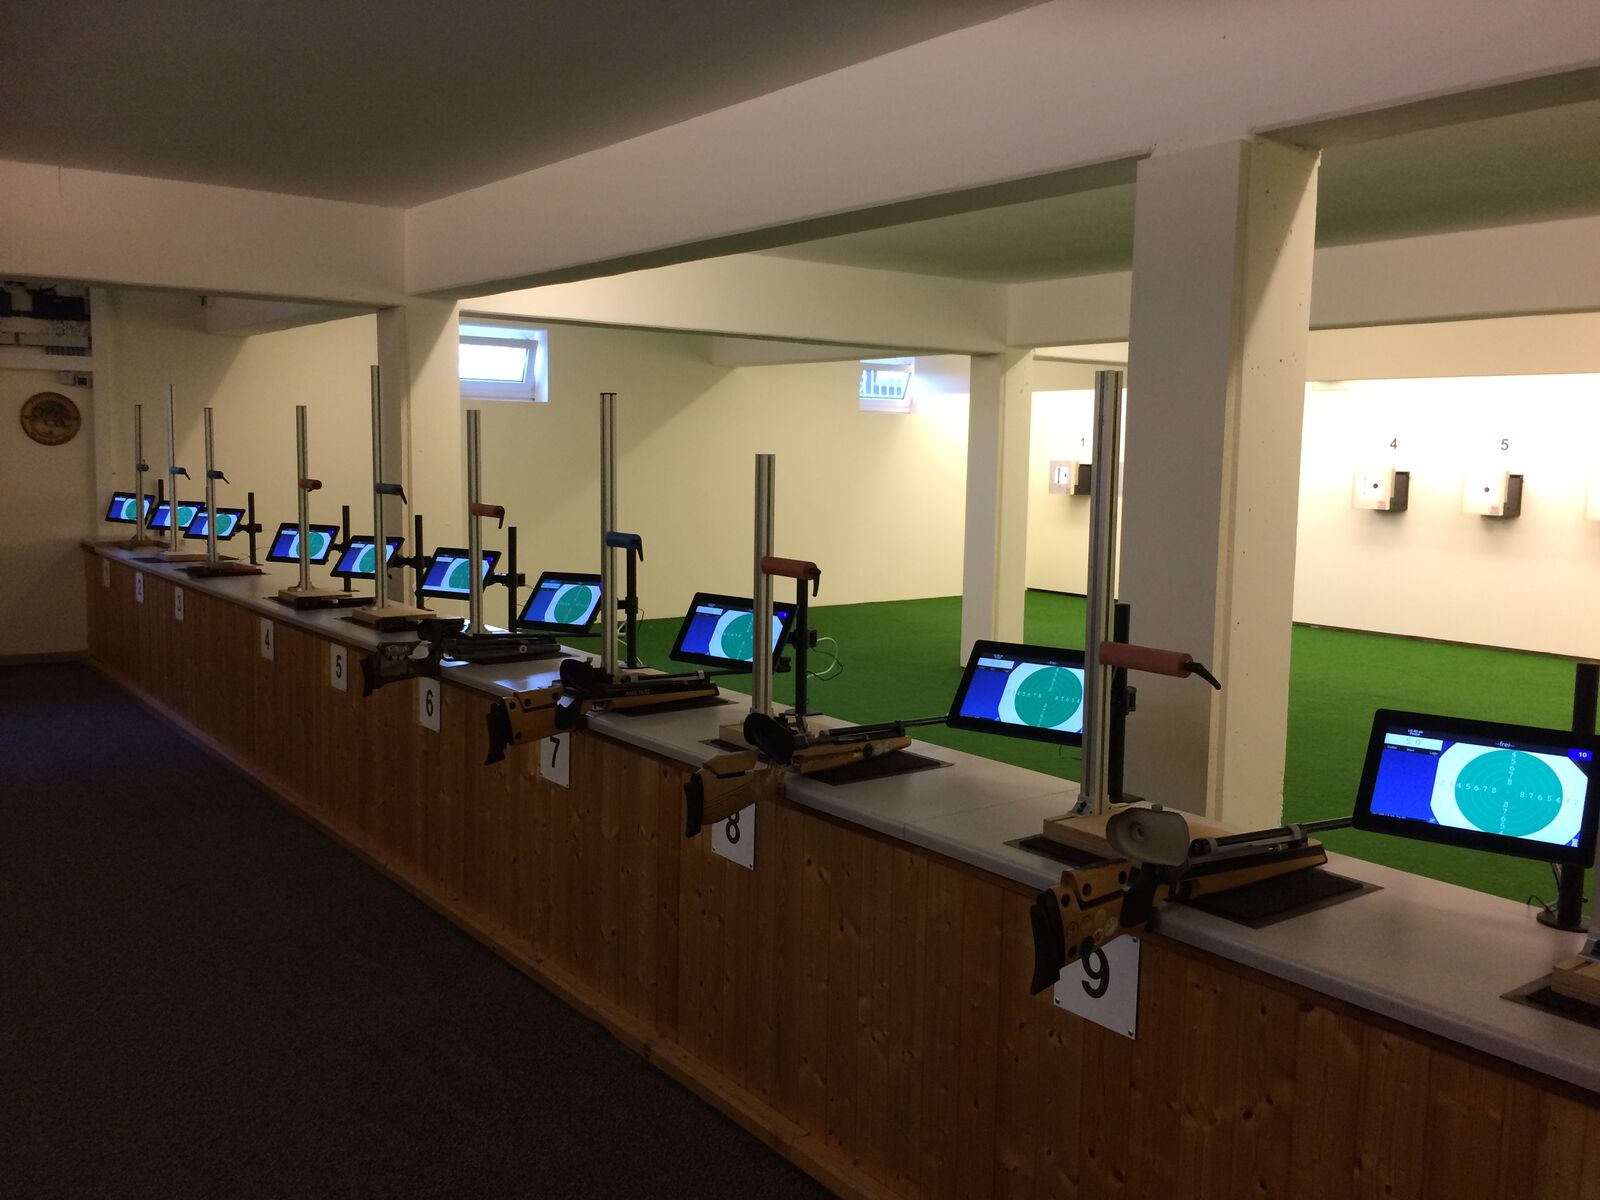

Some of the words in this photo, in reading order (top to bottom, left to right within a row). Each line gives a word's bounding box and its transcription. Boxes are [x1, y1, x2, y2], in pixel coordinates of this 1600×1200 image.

[1389, 437, 1398, 450] 4
[1500, 438, 1509, 451] 5
[264, 628, 270, 650] 4
[335, 654, 342, 679] 5
[425, 688, 434, 717] 6
[549, 735, 561, 768] 7
[725, 812, 741, 845] 8
[1081, 947, 1110, 999] 9
